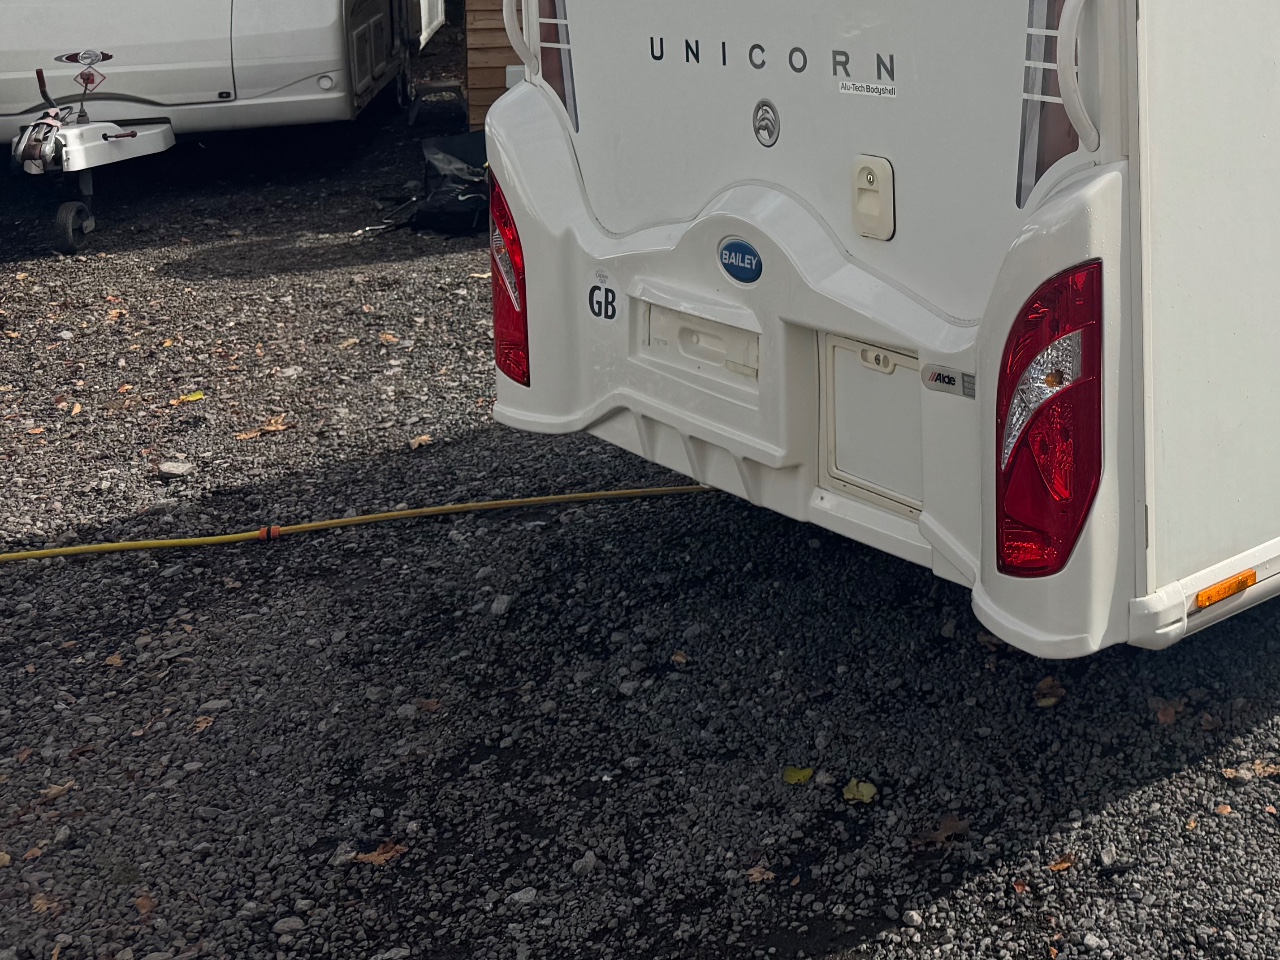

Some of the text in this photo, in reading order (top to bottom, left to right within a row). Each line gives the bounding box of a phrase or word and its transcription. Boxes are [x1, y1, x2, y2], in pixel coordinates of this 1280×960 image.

[650, 36, 895, 81] UNICORN
[840, 82, 896, 96] Alu-Tech Bodyshell
[722, 250, 758, 270] BAILEY
[588, 285, 617, 320] GB
[934, 372, 956, 386] Alde
